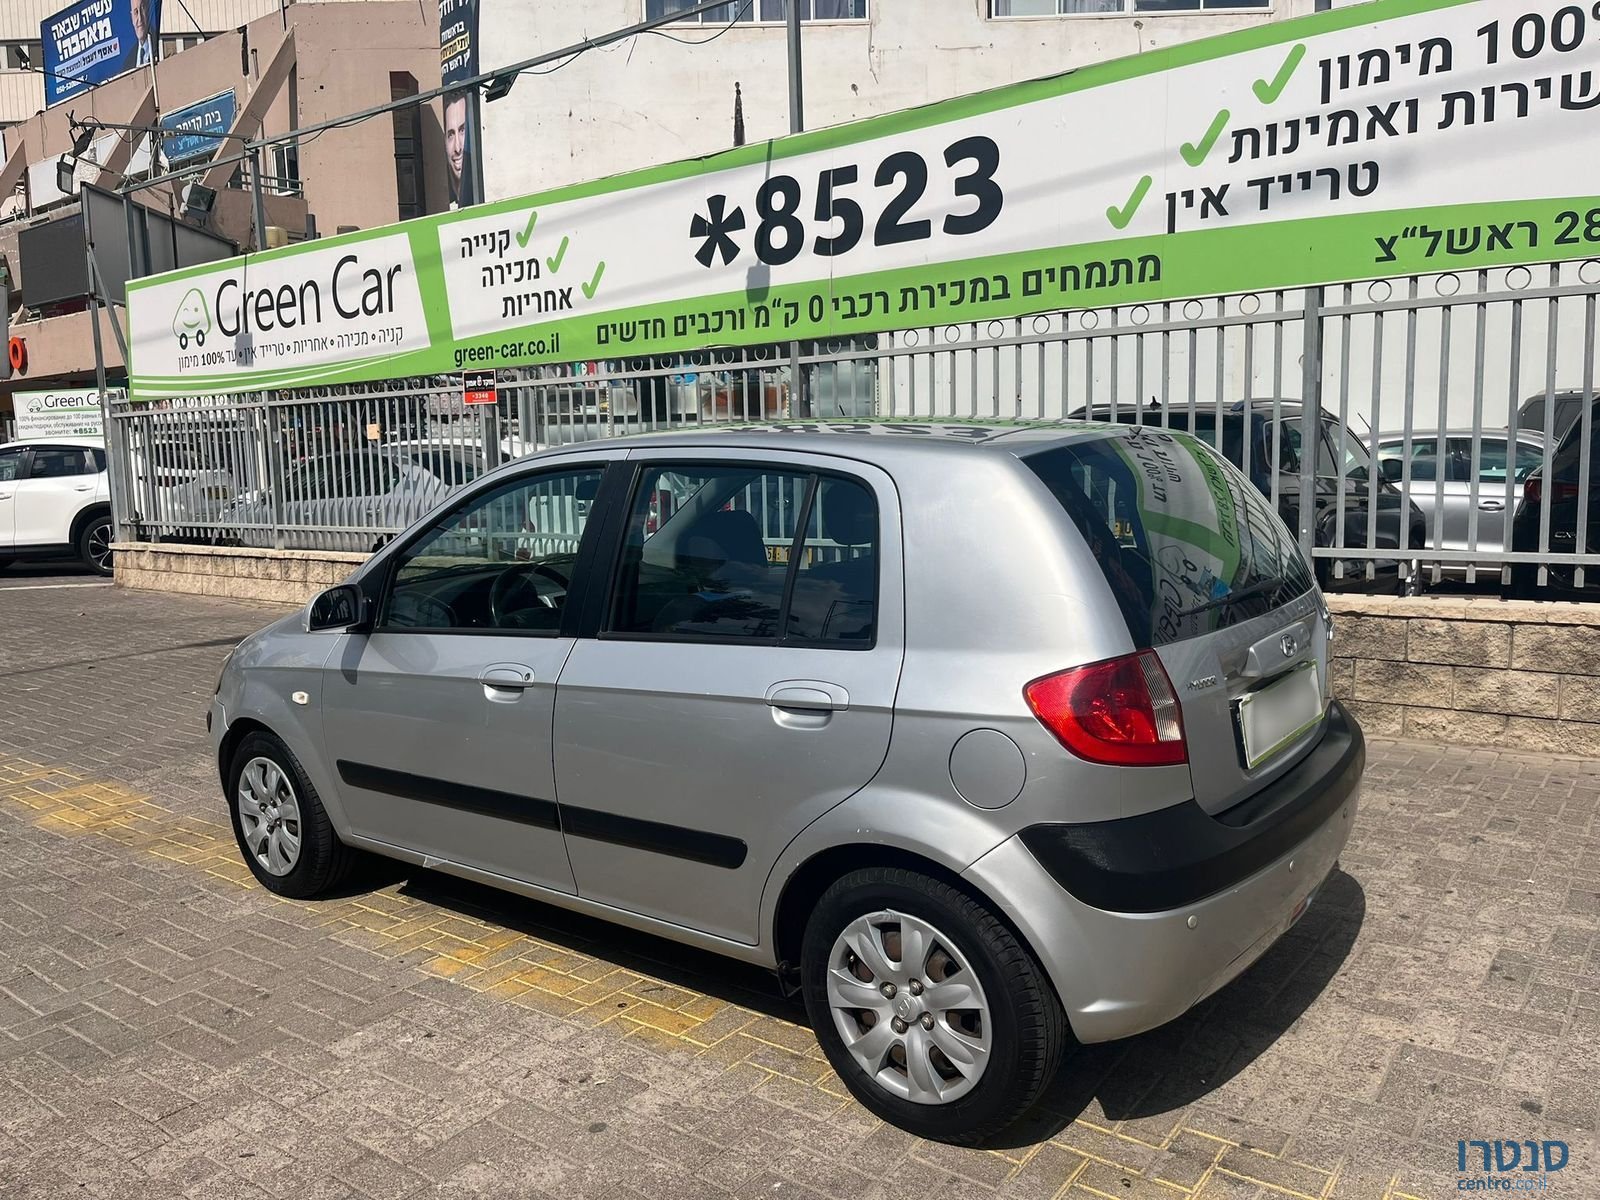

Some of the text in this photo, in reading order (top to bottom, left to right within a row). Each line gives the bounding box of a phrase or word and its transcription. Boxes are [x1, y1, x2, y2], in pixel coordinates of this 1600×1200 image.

[51, 13, 80, 40] שבאה
[56, 17, 112, 61] מאהבה!
[97, 45, 113, 59] אסף
[1318, 1, 1600, 105] 100 מימון
[204, 110, 222, 126] בית
[1228, 98, 1419, 164] ואמינות
[1165, 160, 1379, 234] טרייד אין
[461, 229, 511, 258] קנייה
[1375, 208, 1600, 262] 28 ראשל"צ
[482, 258, 540, 287] מכירה
[1022, 254, 1161, 297] מתמחים
[215, 254, 402, 337] Green Car
[502, 287, 574, 318] אחריות
[808, 294, 824, 323] 0
[832, 291, 889, 320] רכבי
[899, 274, 1011, 312] במכירת
[597, 318, 665, 345] חדשים
[674, 308, 745, 337] ורכבים
[178, 326, 404, 372] קניה מכירה אחריות טרייד אין עד 100% מימון
[454, 332, 560, 367] green-car.co.il
[44, 394, 84, 408] Green
